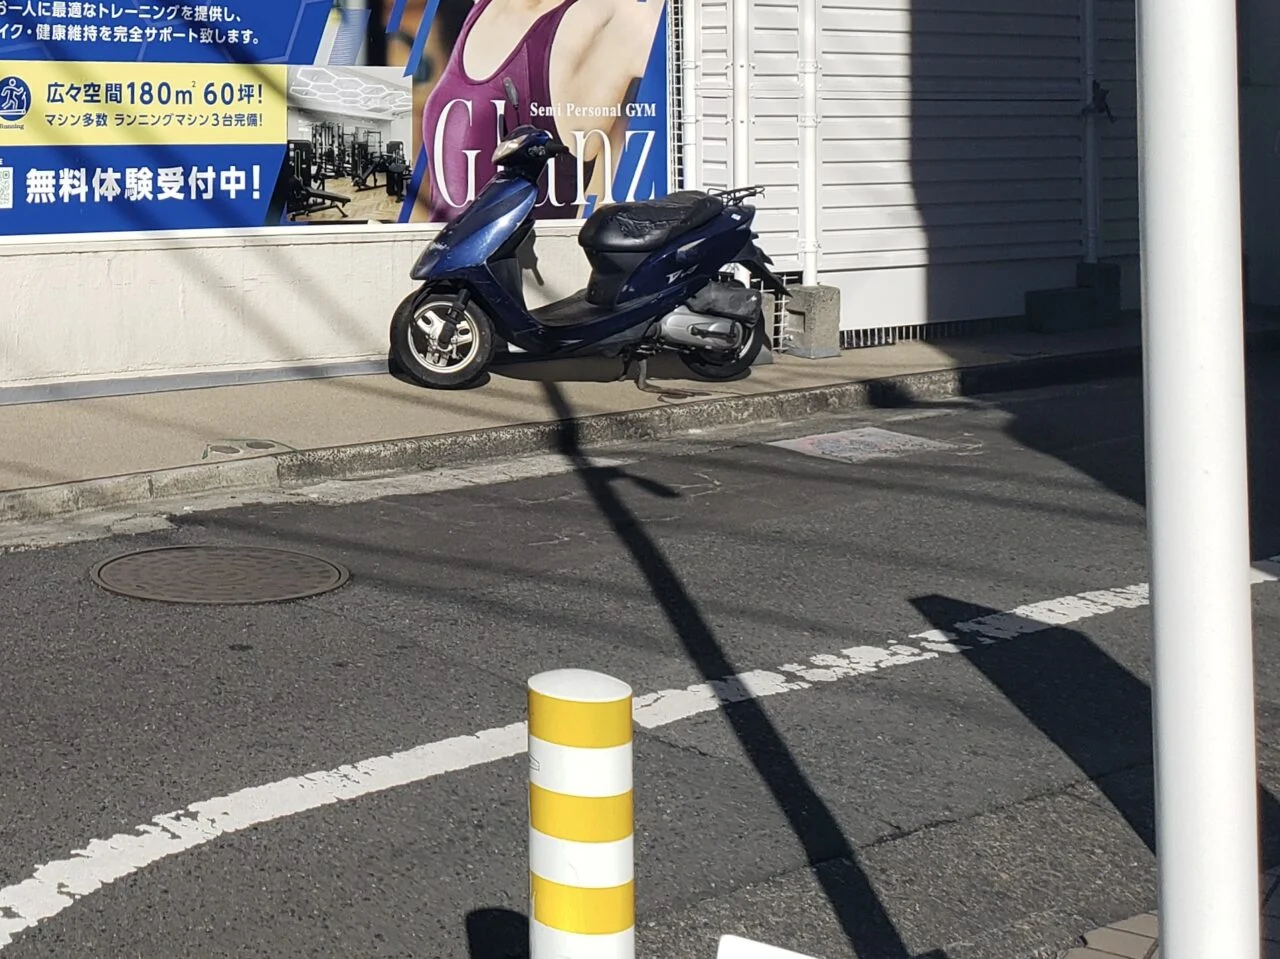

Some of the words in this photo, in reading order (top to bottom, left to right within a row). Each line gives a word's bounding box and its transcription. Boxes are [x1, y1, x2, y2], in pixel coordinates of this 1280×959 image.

[529, 101, 561, 118] Semi
[566, 101, 622, 118] Personal
[625, 101, 657, 118] GYM
[0, 123, 25, 131] Running
[44, 112, 108, 127] マシン多数
[114, 112, 263, 128] ランニングマシン3台完備!
[25, 164, 261, 204] 無料体験受付中!
